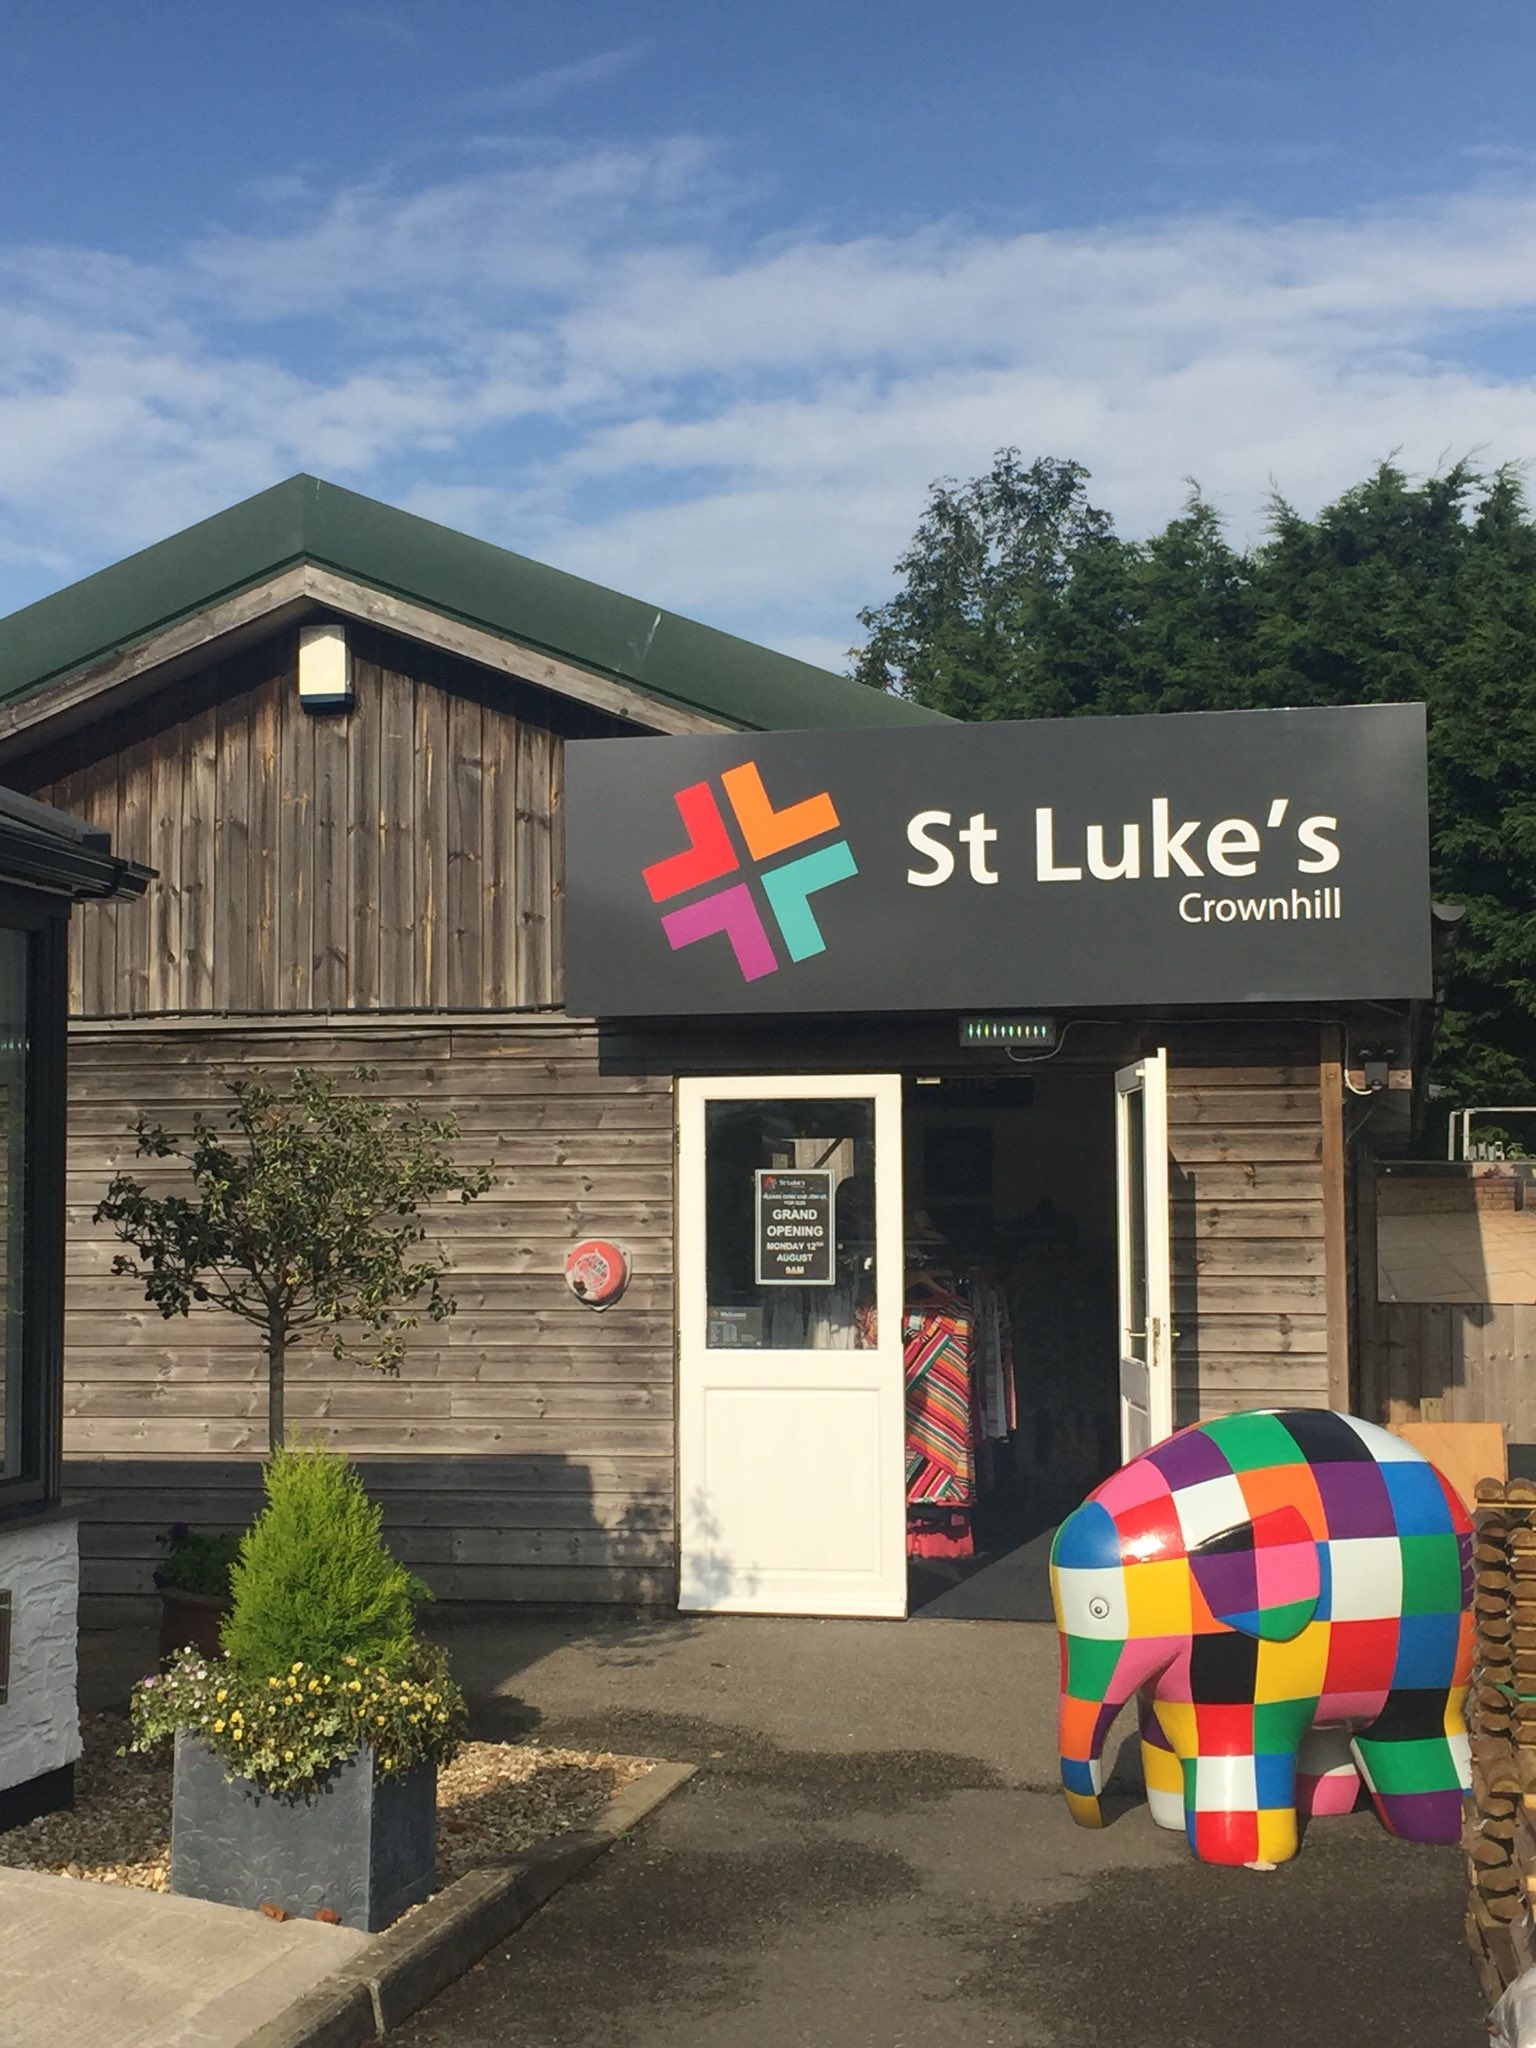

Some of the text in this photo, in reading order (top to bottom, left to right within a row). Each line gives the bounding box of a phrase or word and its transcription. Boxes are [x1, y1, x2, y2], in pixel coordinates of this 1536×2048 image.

[907, 797, 1341, 887] St Luke's
[1178, 887, 1342, 923] Crownhill
[772, 1209, 817, 1220] GRAND
[766, 1225, 824, 1237] OPENING
[766, 1242, 804, 1251] MONDAY
[776, 1253, 813, 1262] AUGUST
[785, 1265, 805, 1274] 9AM
